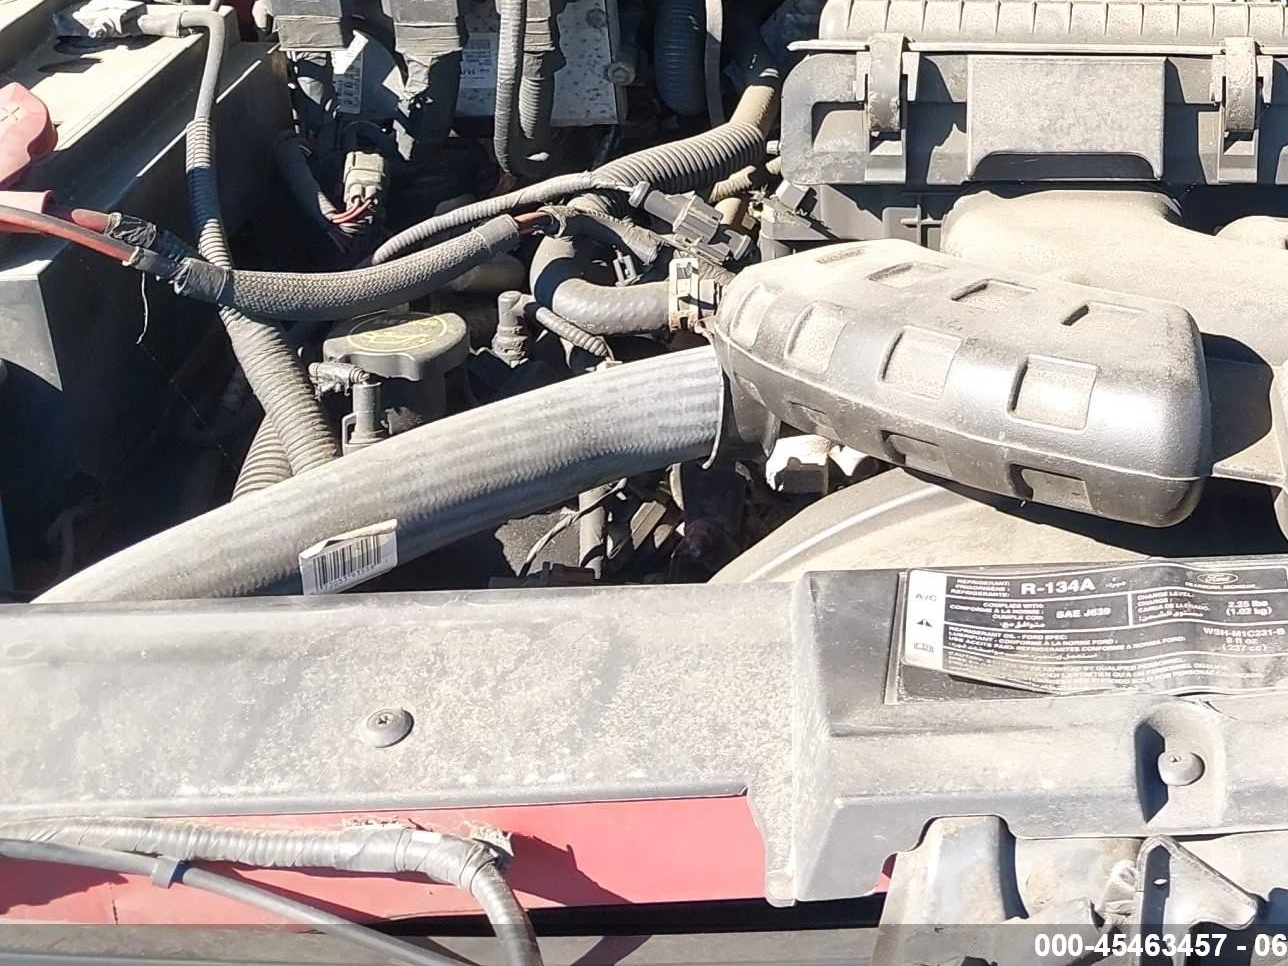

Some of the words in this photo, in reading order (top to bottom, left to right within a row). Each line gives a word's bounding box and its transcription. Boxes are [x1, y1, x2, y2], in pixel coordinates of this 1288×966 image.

[1020, 578, 1096, 595] R-134A
[1227, 600, 1249, 609] 2.25
[1250, 599, 1269, 608] lbs
[1056, 609, 1081, 619] SAE
